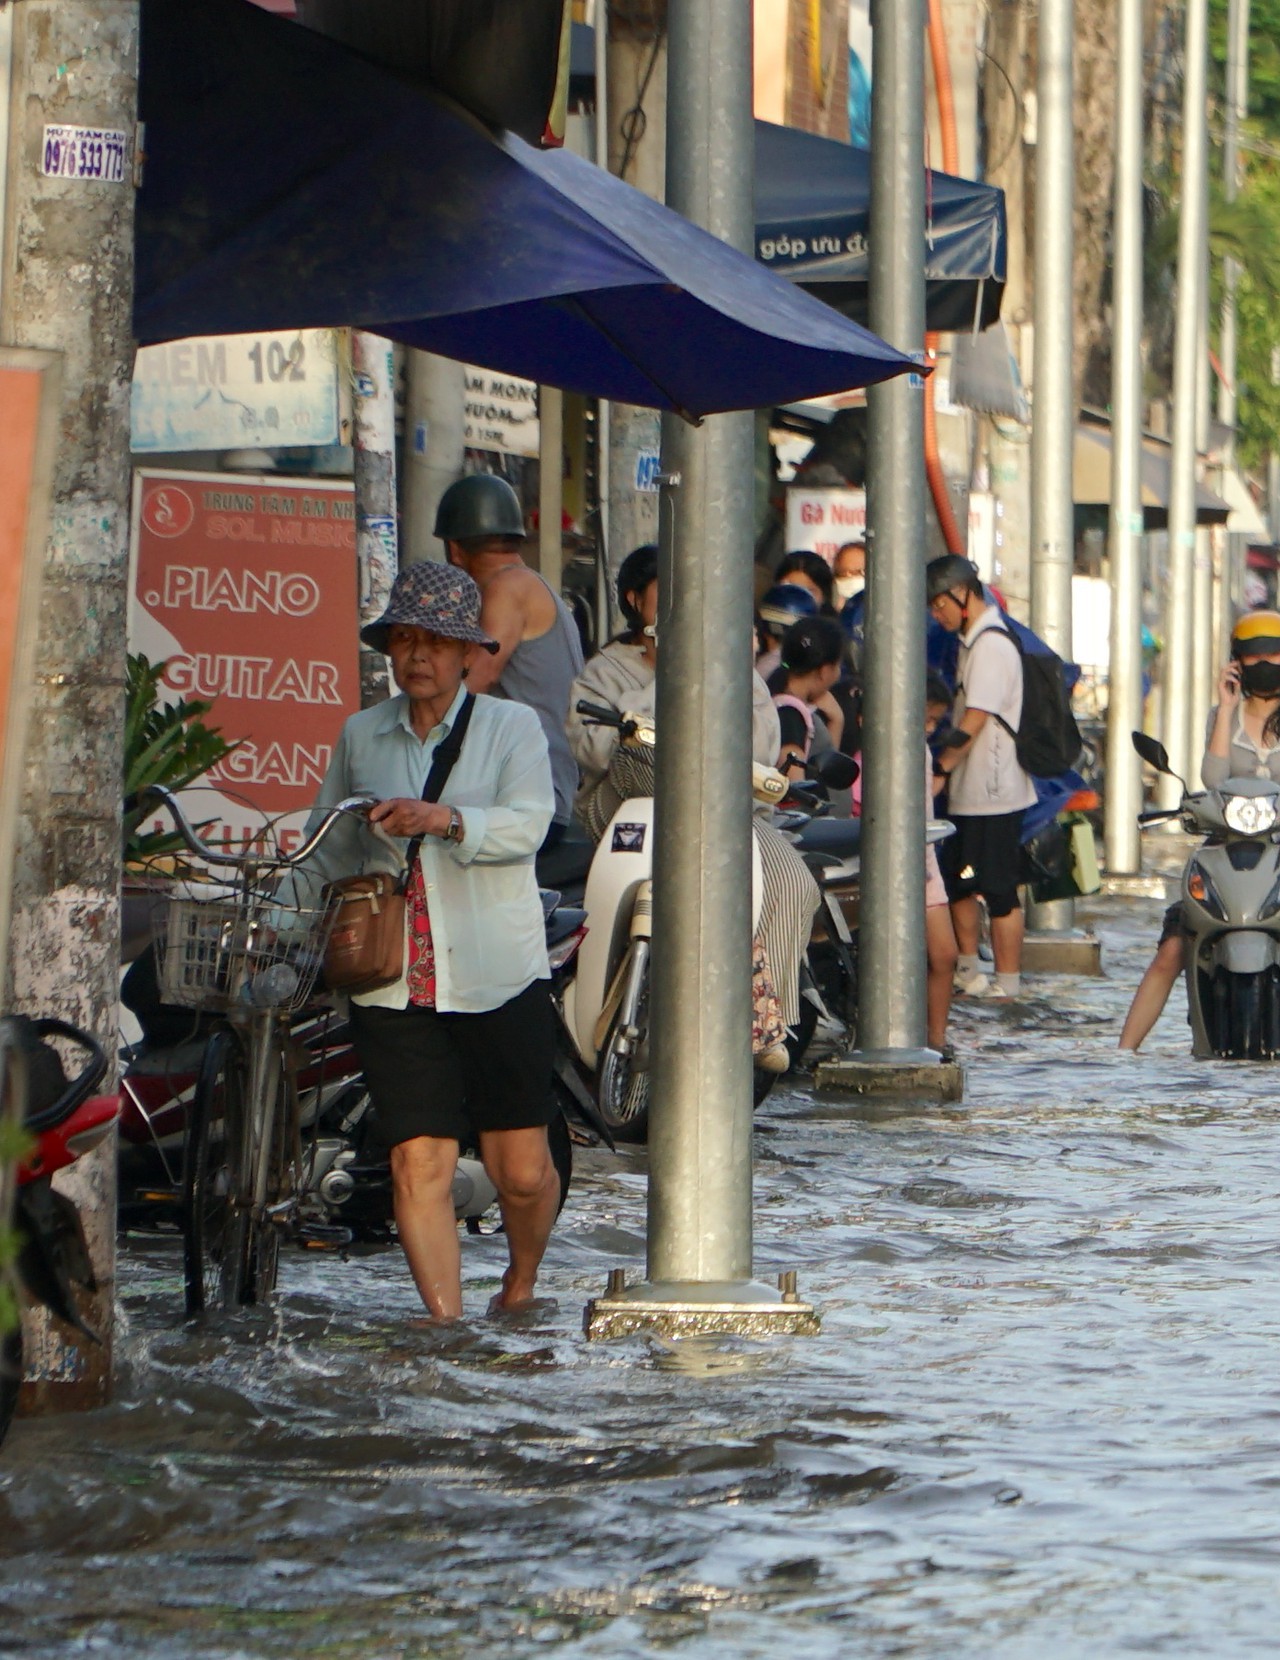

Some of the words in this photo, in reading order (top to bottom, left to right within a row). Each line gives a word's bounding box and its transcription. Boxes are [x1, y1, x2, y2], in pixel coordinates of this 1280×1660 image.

[760, 233, 806, 260] góp
[248, 338, 306, 383] 102
[204, 491, 254, 511] TRUNG
[261, 492, 295, 516] TÂM
[302, 495, 327, 518] ÂM
[206, 515, 265, 543] SOL
[164, 564, 320, 617] PIANO
[162, 653, 343, 705] GUITAR
